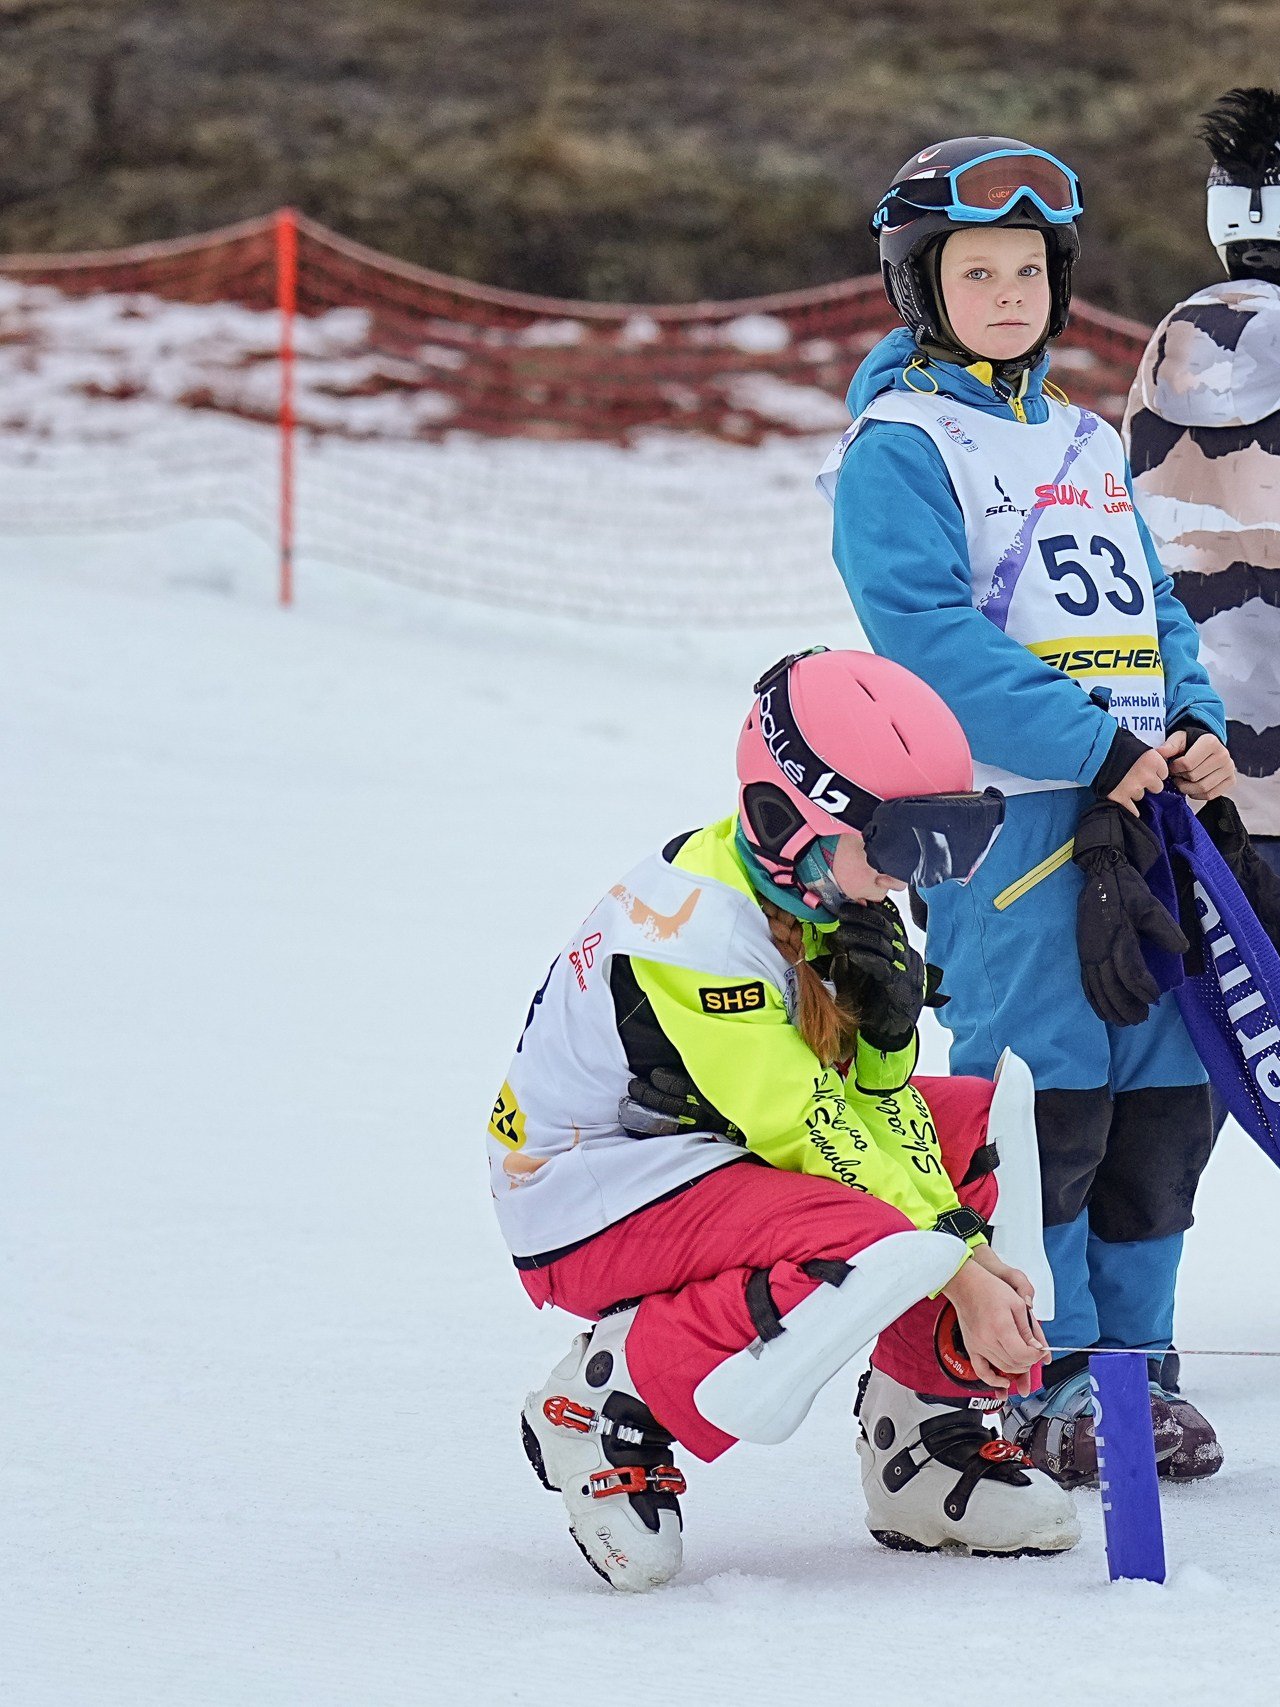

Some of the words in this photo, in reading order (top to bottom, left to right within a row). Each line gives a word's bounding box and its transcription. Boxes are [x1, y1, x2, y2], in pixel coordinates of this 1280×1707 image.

[1038, 534, 1145, 616] 53
[1110, 693, 1160, 708] ЫЖНЫЙ
[759, 686, 806, 784] bollé
[1132, 716, 1166, 732] ТЯГА
[568, 949, 589, 993] öffler
[705, 987, 760, 1011] SHS
